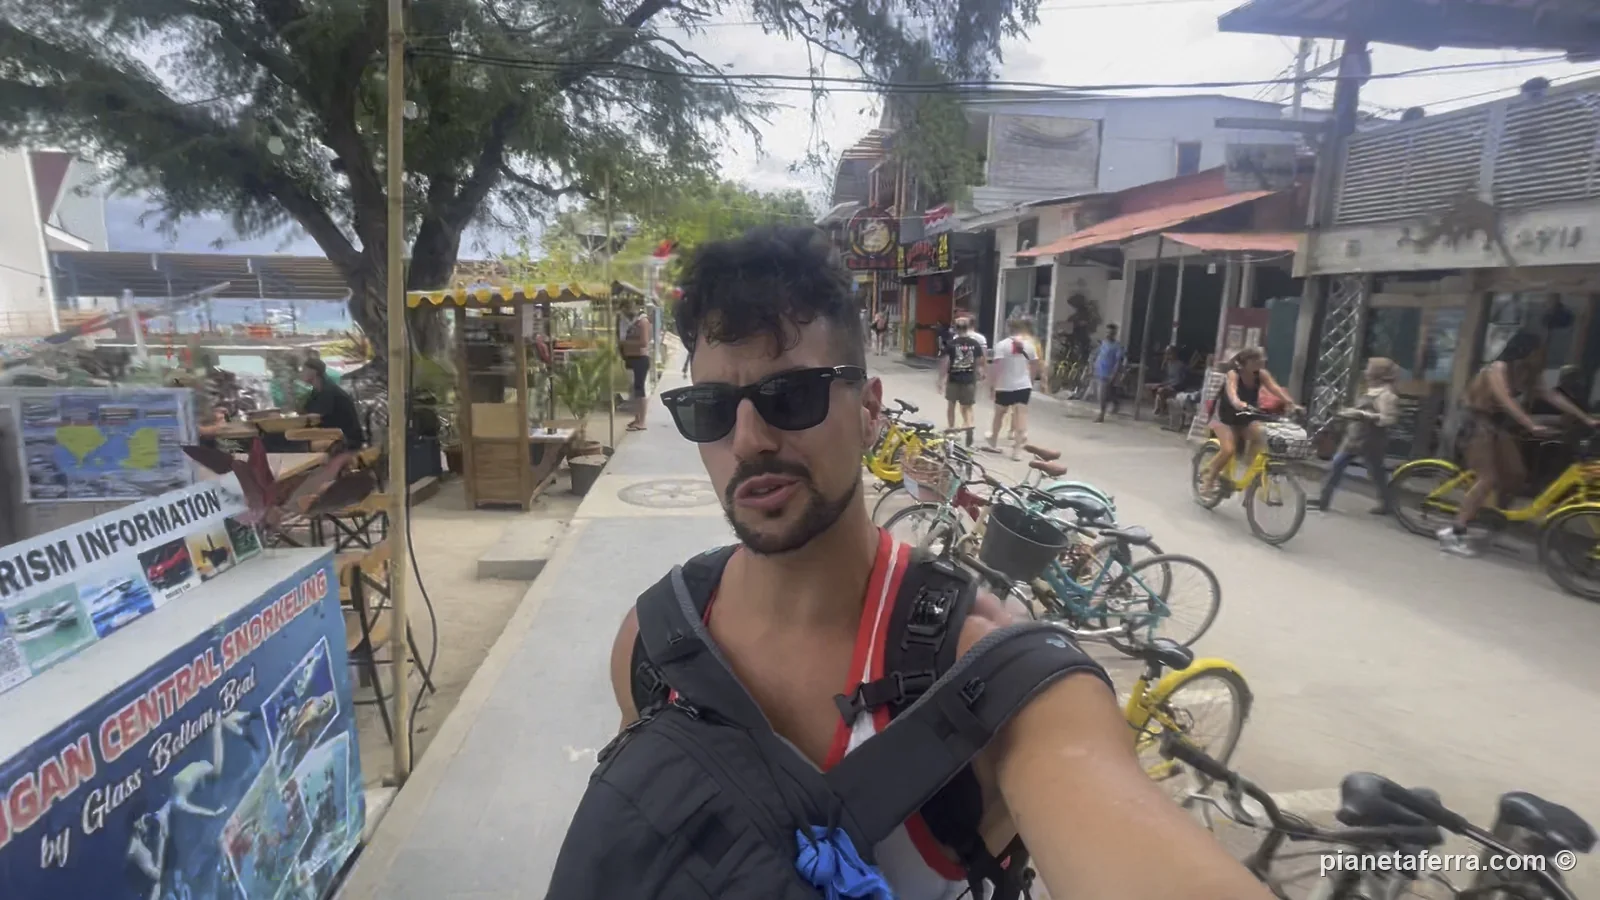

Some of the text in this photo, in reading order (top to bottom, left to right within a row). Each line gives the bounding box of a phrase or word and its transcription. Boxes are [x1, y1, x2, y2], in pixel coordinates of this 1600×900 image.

[76, 489, 221, 564] INFORMATION
[100, 647, 221, 763] CENTRAL
[221, 568, 328, 673] SNORKELING
[40, 828, 70, 868] by
[82, 768, 142, 835] Glass
[148, 707, 214, 776] Bottom
